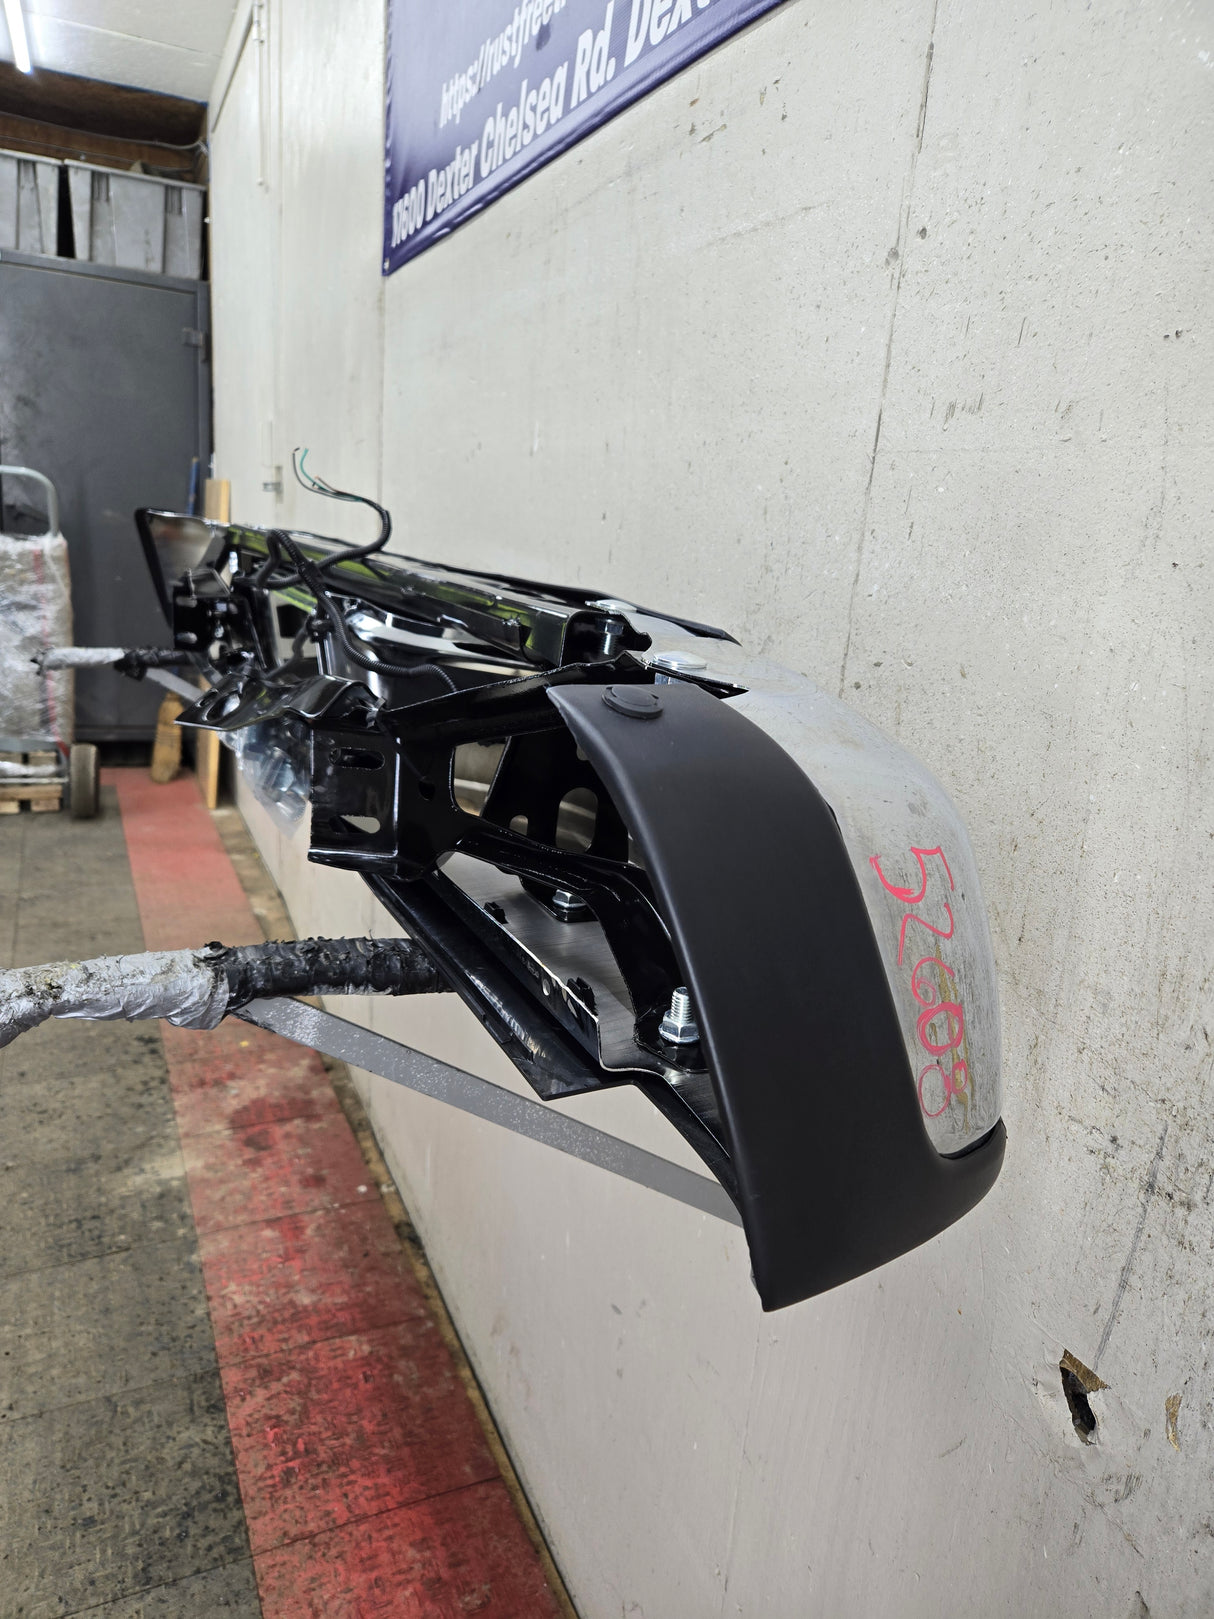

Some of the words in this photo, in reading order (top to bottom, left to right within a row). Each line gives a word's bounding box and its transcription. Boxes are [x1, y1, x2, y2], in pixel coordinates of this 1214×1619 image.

[425, 135, 480, 221] Dexter
[480, 61, 568, 178] Chelsea
[570, 0, 616, 109] Rd.
[623, 0, 711, 68] De
[869, 846, 967, 1118] 52608
